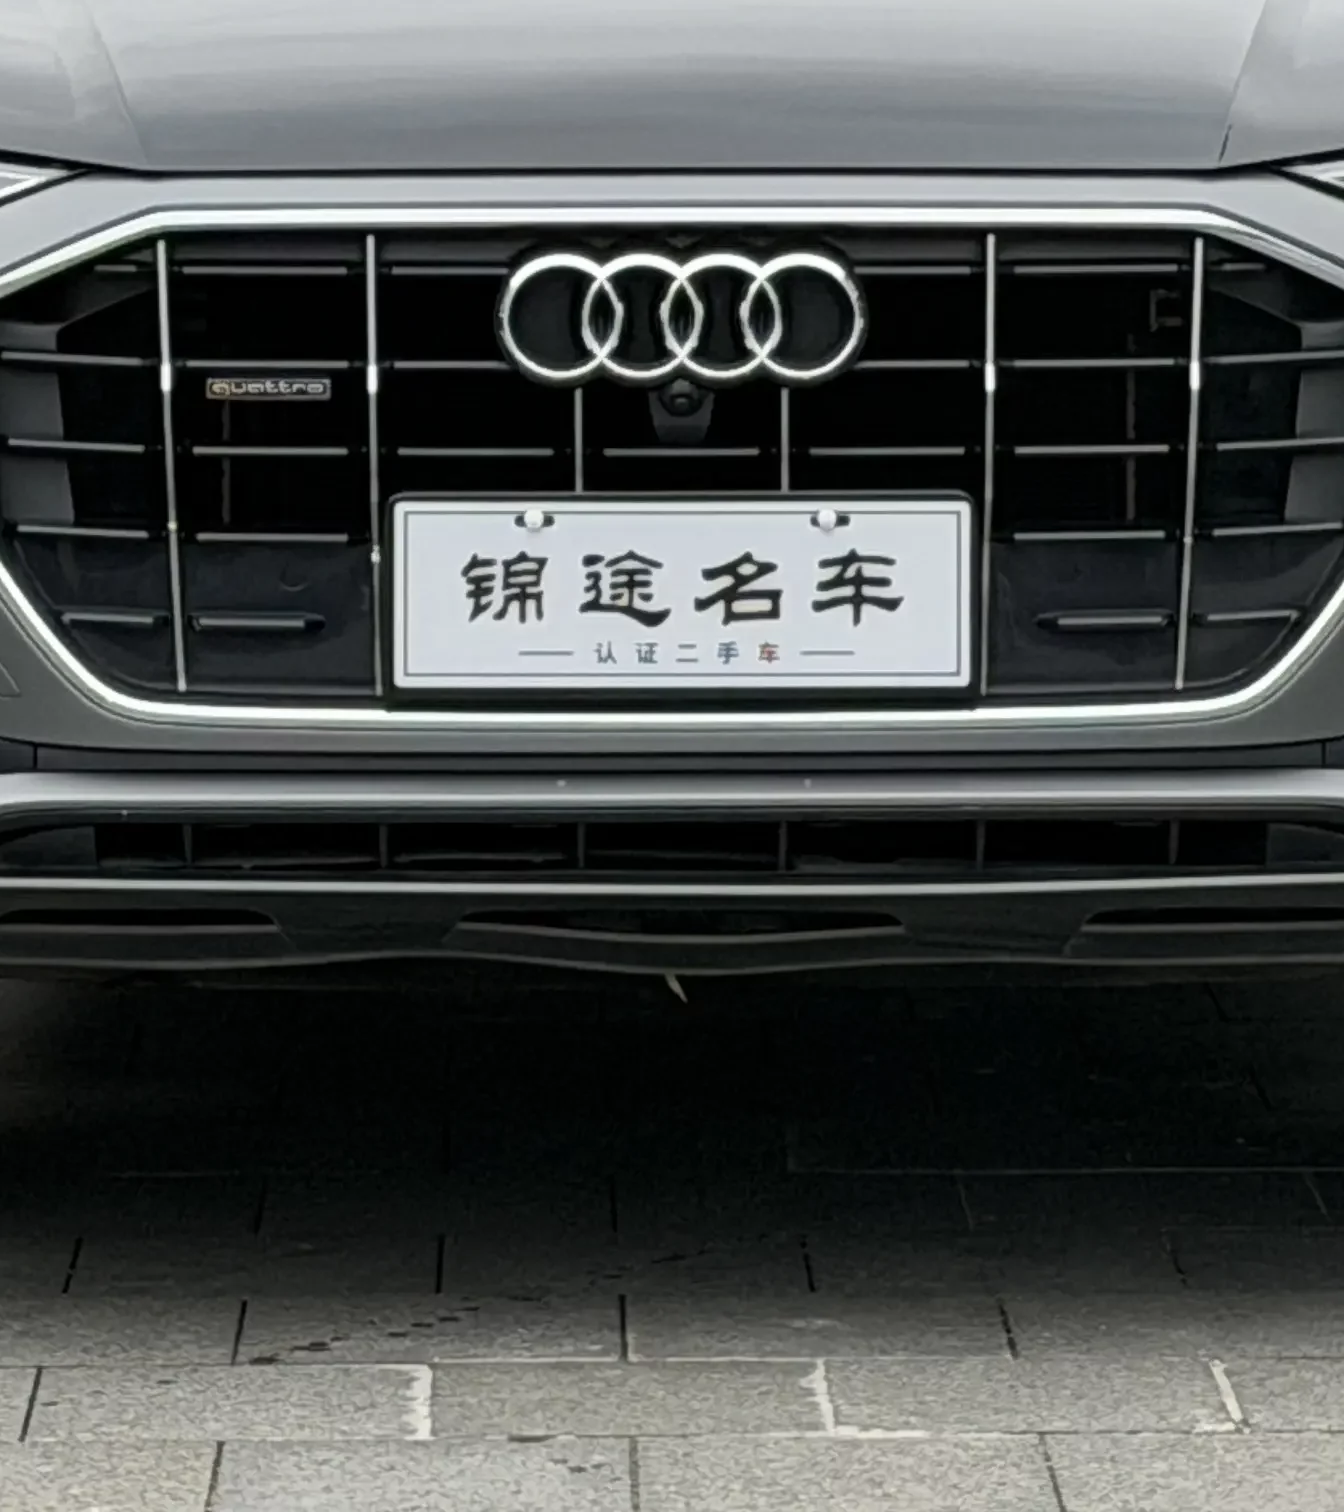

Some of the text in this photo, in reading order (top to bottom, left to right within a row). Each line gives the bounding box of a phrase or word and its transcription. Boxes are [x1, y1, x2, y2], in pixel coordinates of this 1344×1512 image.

[210, 380, 325, 396] quattro
[460, 548, 905, 627] 锦途名车
[594, 641, 781, 665] 认证二手车
